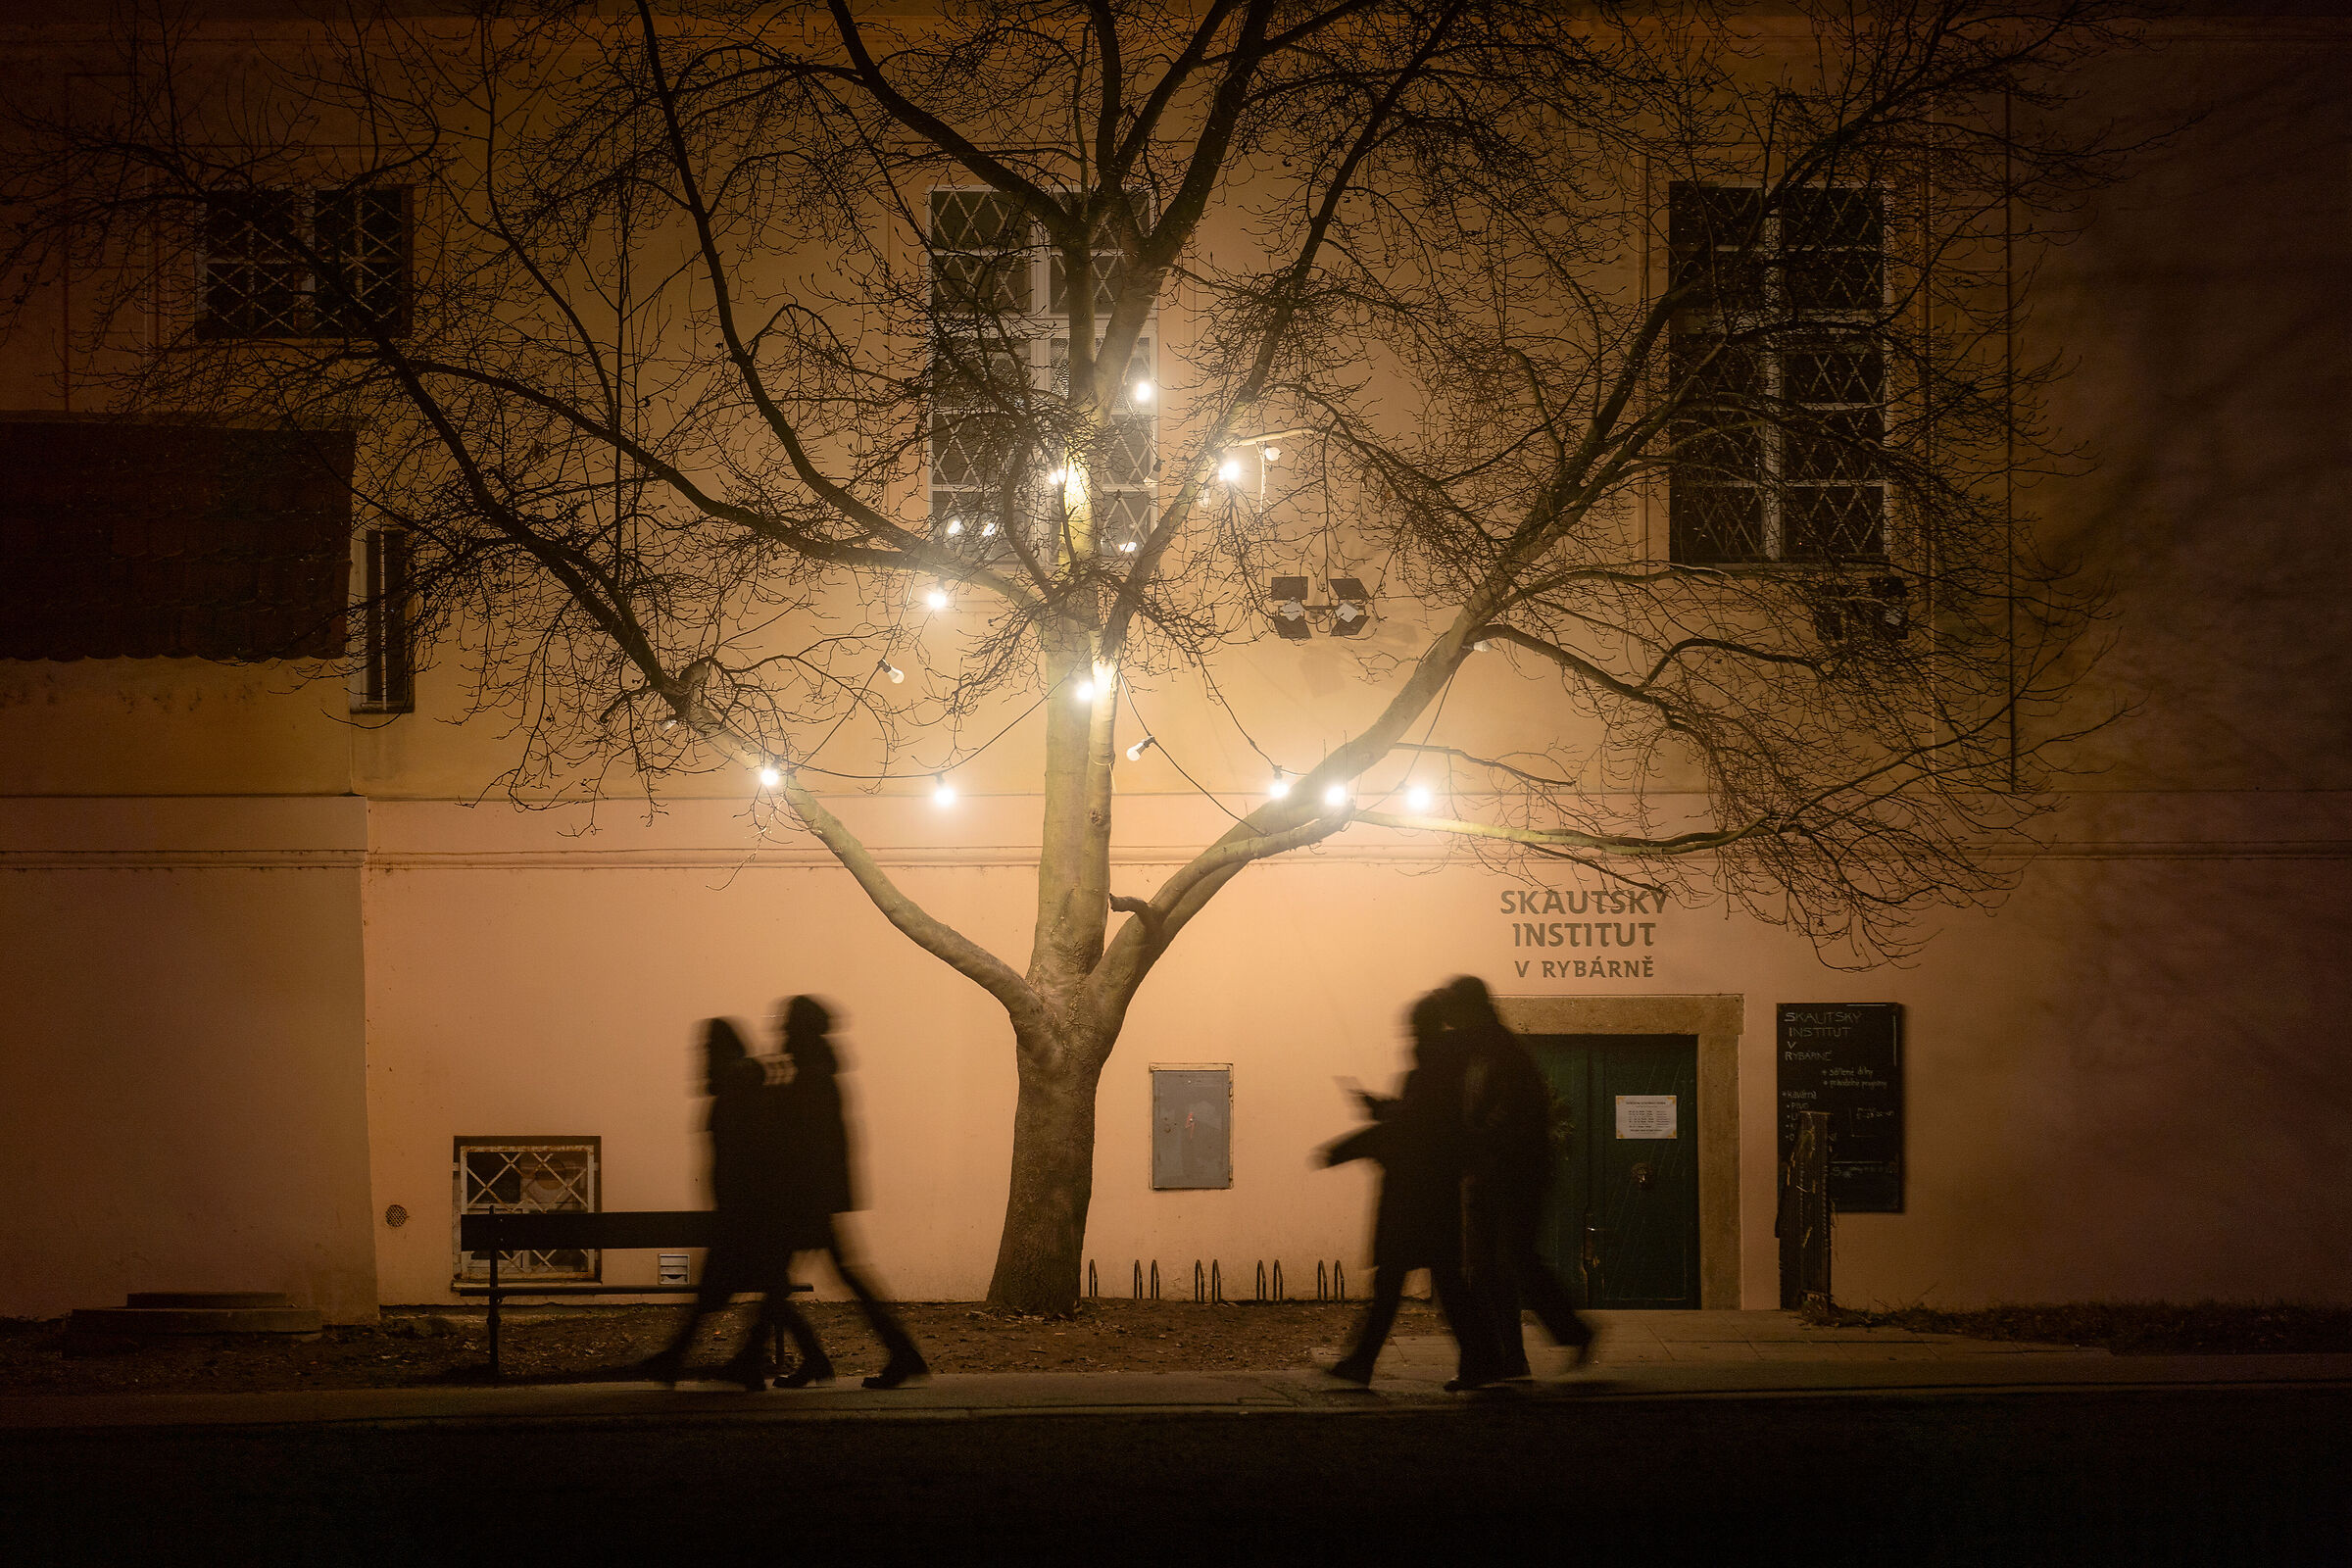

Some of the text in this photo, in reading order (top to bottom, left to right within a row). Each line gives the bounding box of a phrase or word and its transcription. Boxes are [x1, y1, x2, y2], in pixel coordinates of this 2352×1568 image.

[1512, 922, 1656, 947] INSTITUT
[1514, 956, 1654, 978] V RYBÁRNĚ
